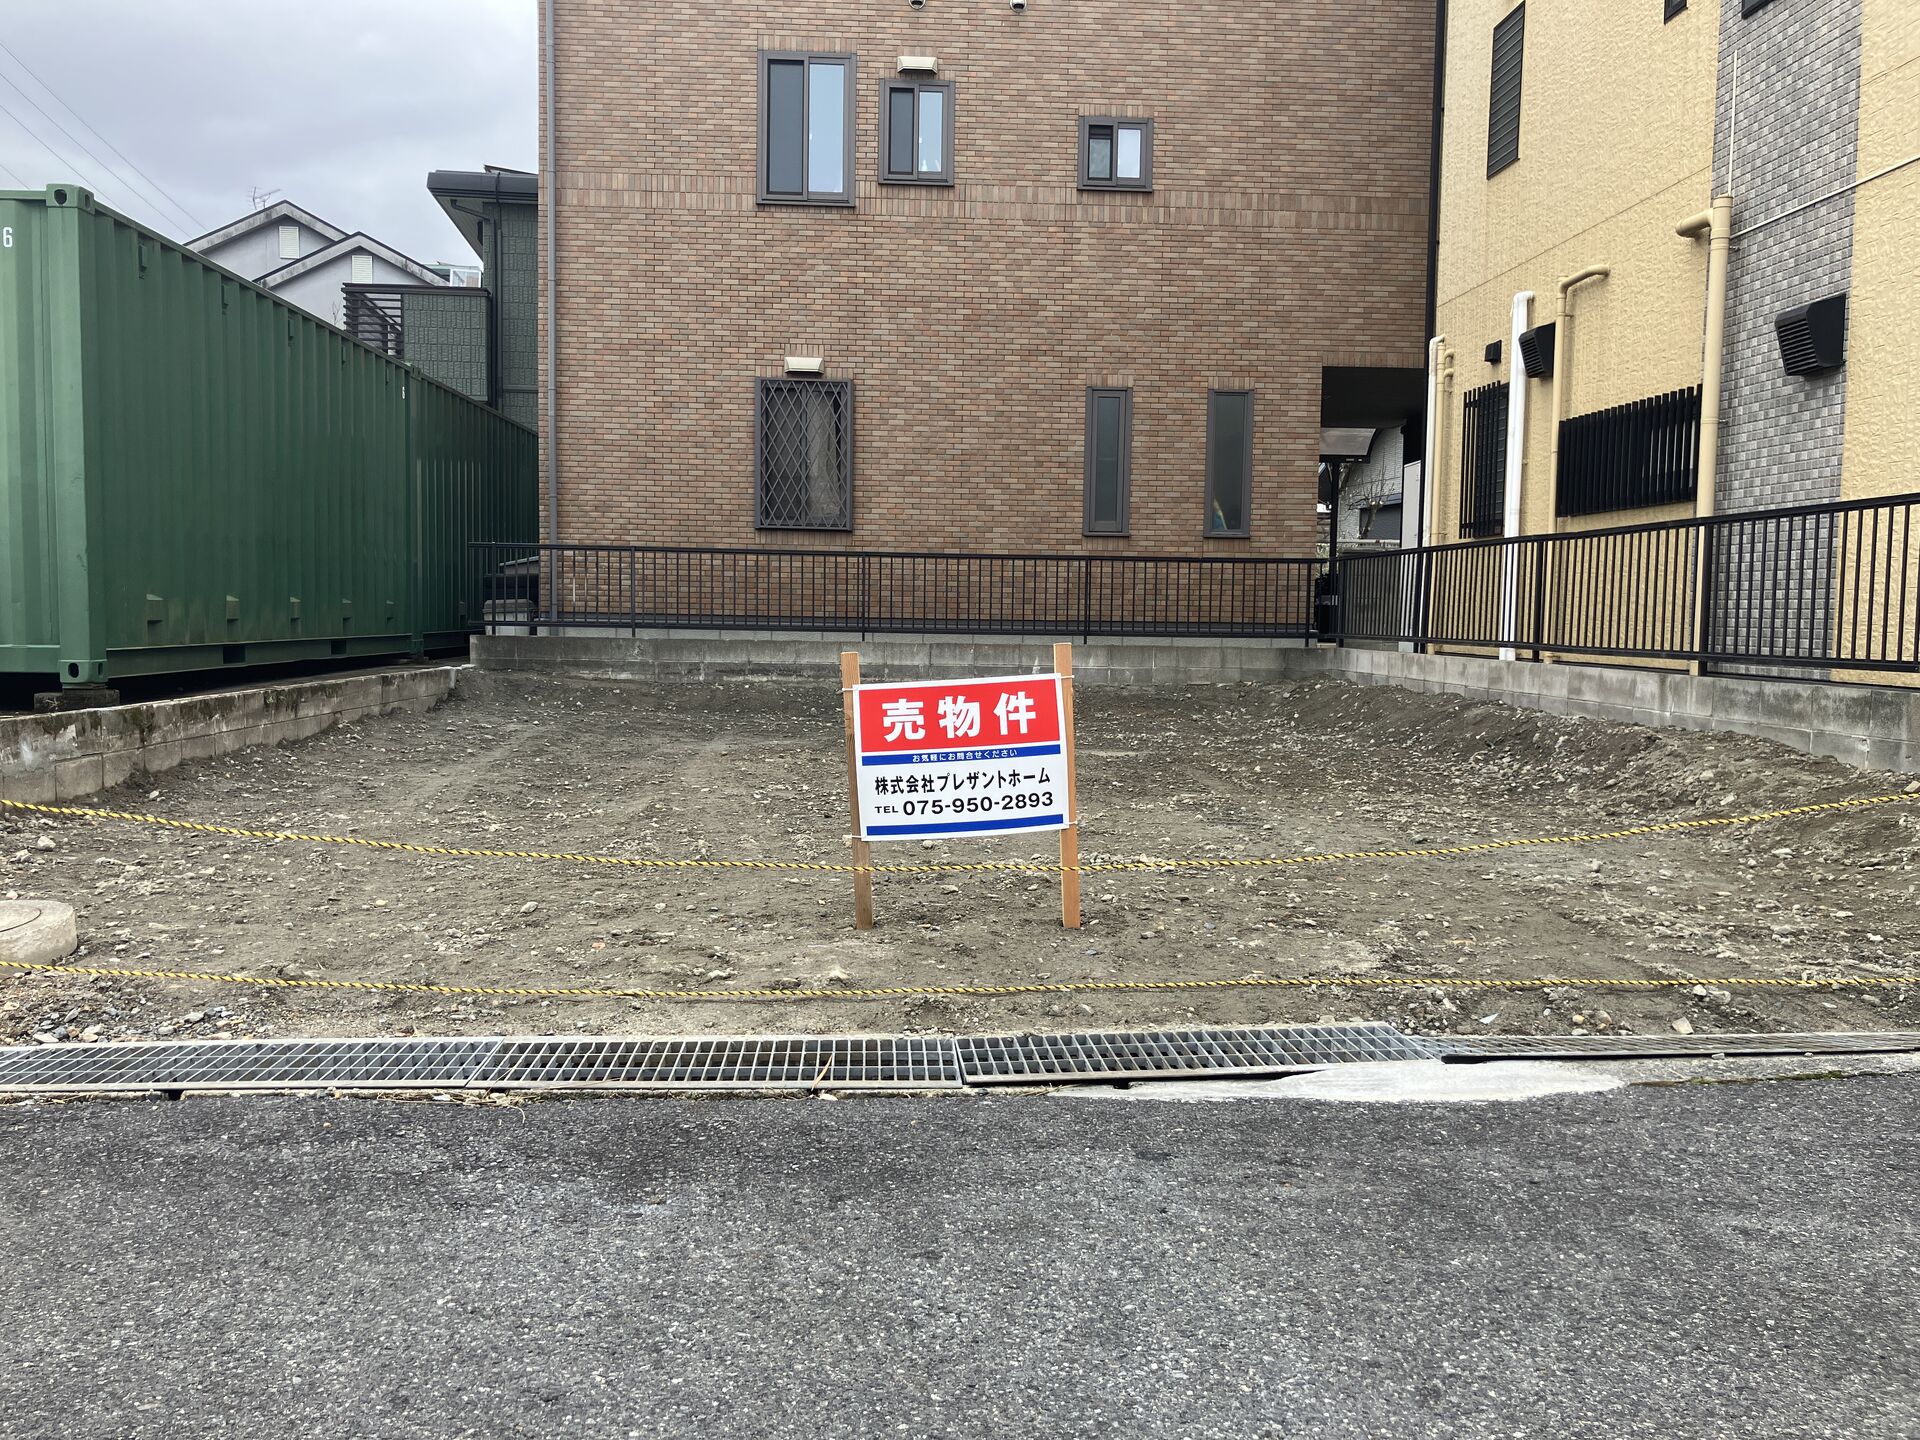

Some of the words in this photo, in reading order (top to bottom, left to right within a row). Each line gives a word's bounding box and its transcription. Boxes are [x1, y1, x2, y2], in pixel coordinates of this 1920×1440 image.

[3, 226, 13, 248] 6
[881, 691, 1037, 743] 売物件
[912, 749, 1018, 763] お気軽にお問合せください
[874, 767, 1051, 796] 株式会社プレザントホーム
[874, 805, 899, 814] TEL
[903, 791, 1054, 816] 075-950-2893
